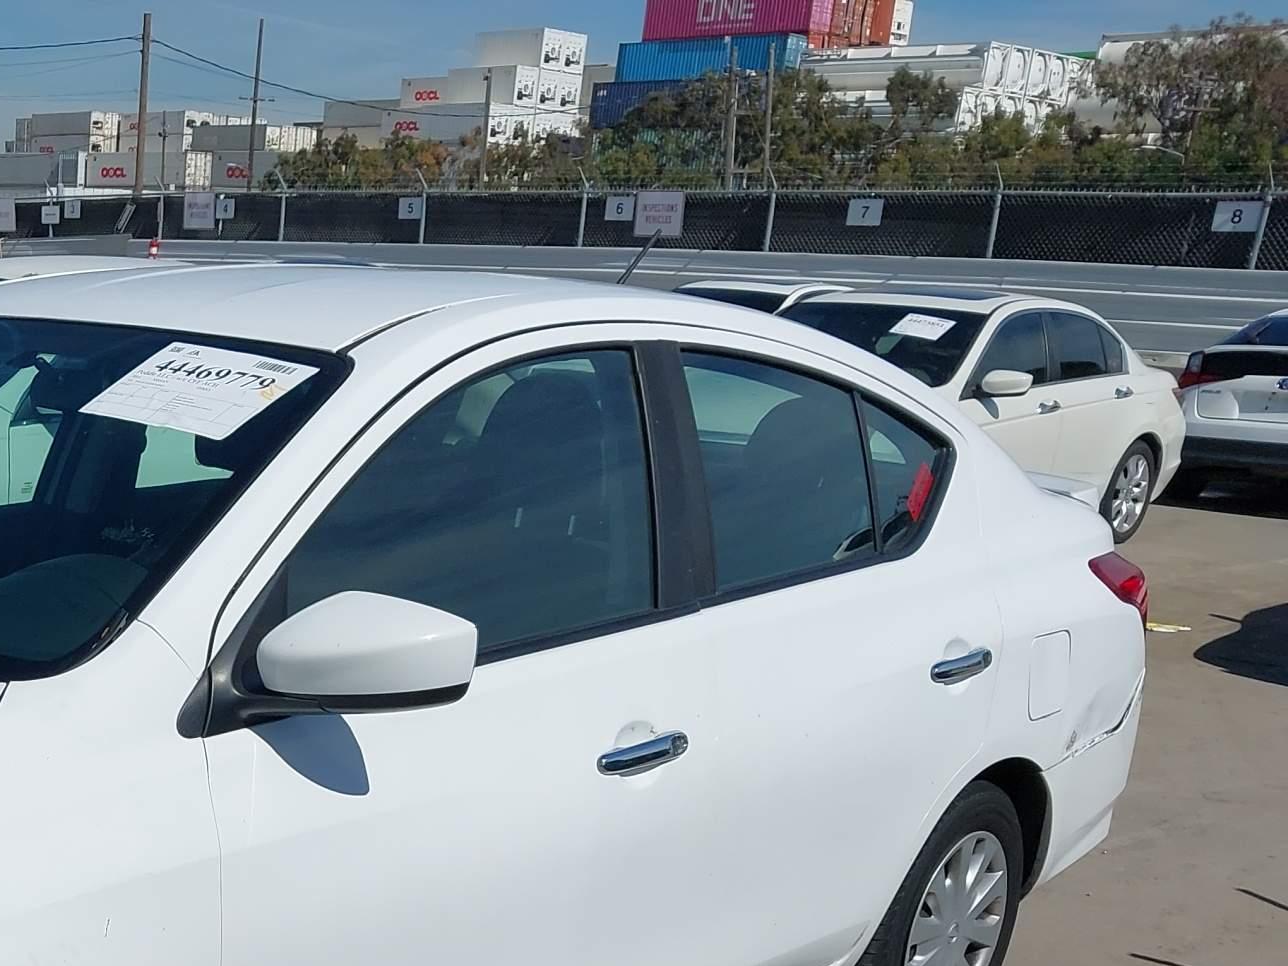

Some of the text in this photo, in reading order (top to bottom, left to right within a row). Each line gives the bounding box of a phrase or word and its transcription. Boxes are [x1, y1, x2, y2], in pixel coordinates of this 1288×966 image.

[415, 90, 440, 101] OOCL
[395, 121, 420, 132] OOCL
[101, 167, 127, 178] OOCL
[407, 202, 414, 214] 5
[615, 202, 624, 215] 6
[861, 205, 871, 219] 7
[1231, 208, 1243, 225] 8
[154, 359, 276, 391] 44469779
